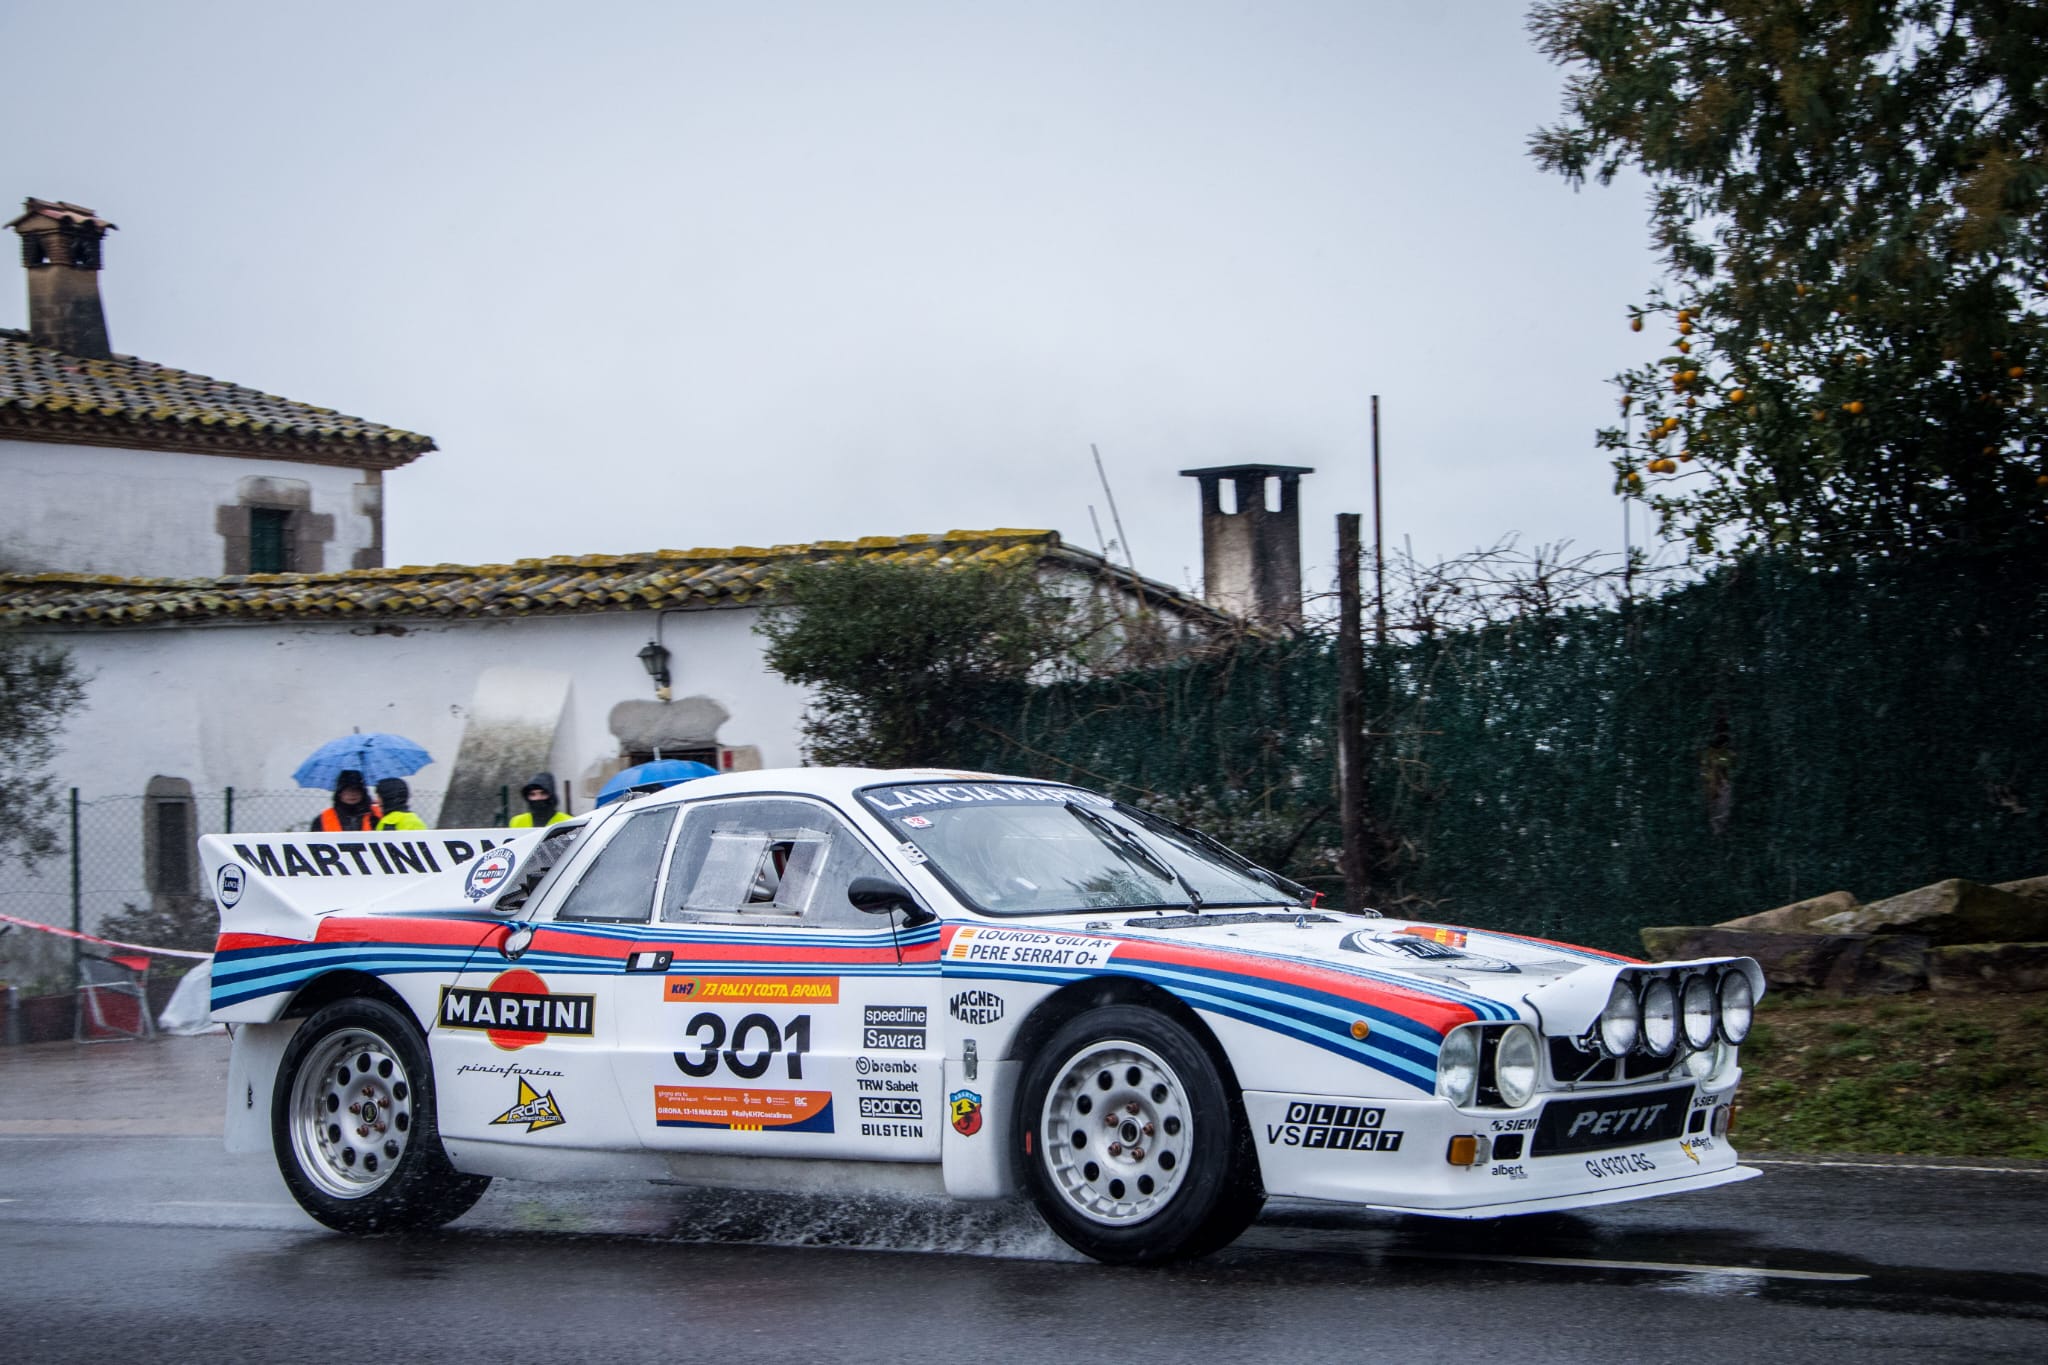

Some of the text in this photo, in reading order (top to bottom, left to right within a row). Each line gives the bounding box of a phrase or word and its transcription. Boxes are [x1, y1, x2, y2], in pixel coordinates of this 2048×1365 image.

[865, 787, 996, 811] LANCIA
[233, 843, 441, 877] MARTINI
[476, 869, 505, 879] MARTINI
[978, 929, 1050, 943] LOURDES
[970, 944, 1098, 965] PERE SERRAT O+
[702, 983, 718, 997] 73
[718, 983, 753, 997] RALLY
[753, 984, 788, 997] COSTA
[791, 984, 832, 998] BRAVA
[950, 990, 1004, 1007] MAGNETI
[446, 994, 588, 1029] MARTINI
[865, 1008, 926, 1024] speedline
[950, 1007, 1004, 1024] MARELLI
[673, 1012, 811, 1080] 301
[867, 1030, 923, 1049] Savara
[457, 1063, 564, 1078] pininfarina
[857, 1079, 918, 1093] TRW Sabelt
[508, 1097, 553, 1121] RdR
[862, 1099, 921, 1116] sparco
[1288, 1104, 1381, 1128] OLIO
[1503, 1118, 1538, 1131] SIEM
[1567, 1103, 1668, 1138] PETIT
[861, 1123, 923, 1138] BILSTEIN
[1266, 1123, 1400, 1150] VS FIAT
[1491, 1164, 1524, 1176] albert
